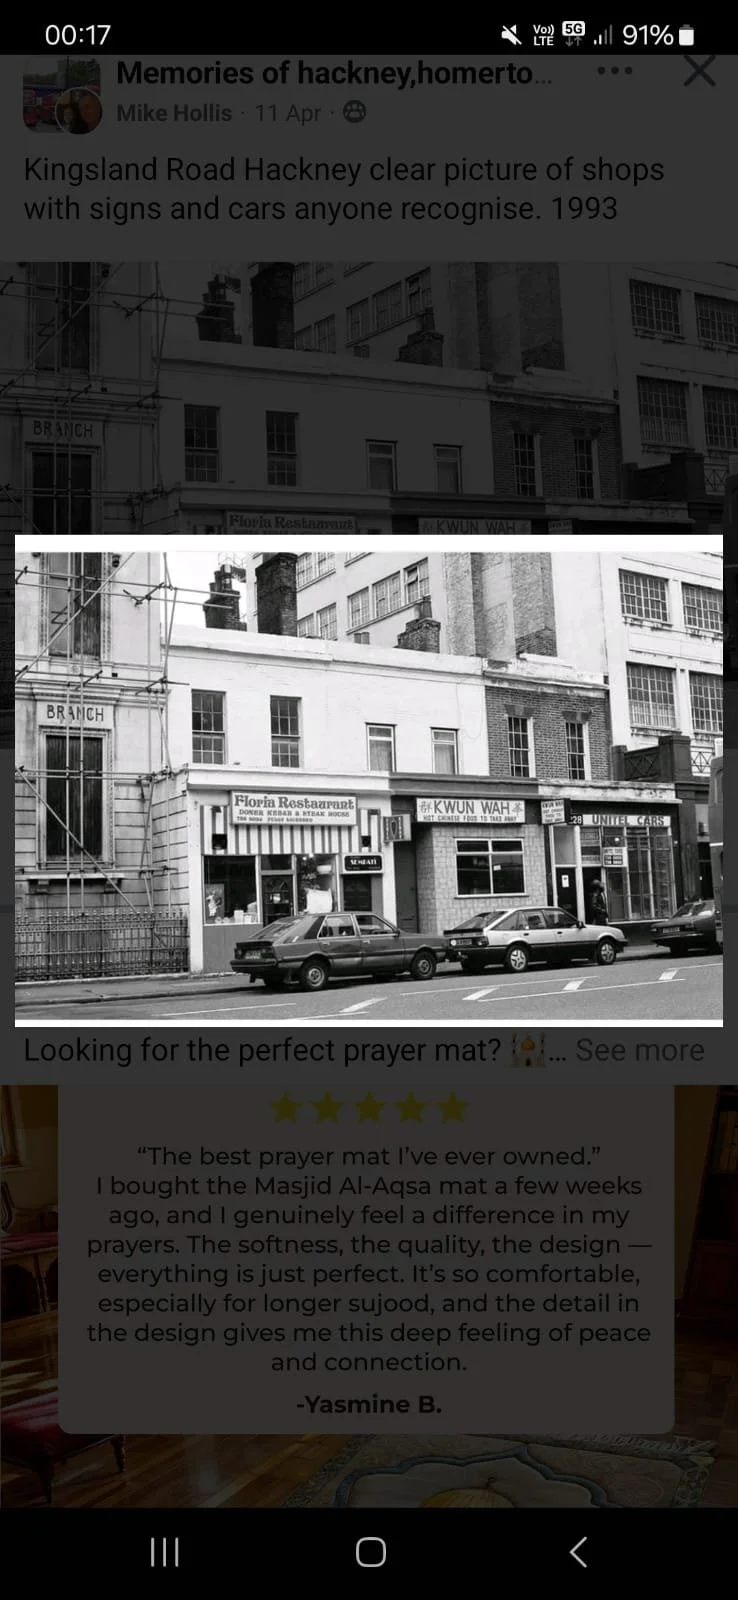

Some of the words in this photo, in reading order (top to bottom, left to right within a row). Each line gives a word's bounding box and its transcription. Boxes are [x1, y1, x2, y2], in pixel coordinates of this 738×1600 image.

[46, 25, 111, 45] 00:17
[565, 23, 583, 35] 5G
[622, 24, 674, 46] 91%
[533, 36, 554, 46] LTE
[118, 61, 253, 84] Memories
[263, 60, 290, 84] of
[117, 104, 168, 122] Mike
[174, 104, 232, 122] Hollis
[256, 105, 276, 121] 11
[286, 104, 321, 126] Apr
[26, 156, 156, 186] Kingsland
[168, 156, 234, 180] Road
[245, 156, 361, 187] Hackney
[370, 156, 436, 180] clear
[445, 156, 536, 186] picture
[547, 156, 574, 180] of
[583, 156, 664, 187] shops
[24, 195, 79, 219] with
[90, 196, 161, 225] signs
[171, 195, 218, 219] and
[229, 202, 285, 219] cars
[296, 202, 392, 226] anyone
[402, 196, 540, 225] recognise.
[552, 196, 617, 219] 1993
[33, 420, 93, 438] BRANCH
[47, 704, 104, 722] BRANCH
[234, 794, 275, 808] Floria
[278, 796, 354, 810] Restaurant
[434, 800, 475, 814] KWUN
[481, 800, 510, 815] WAH
[592, 815, 629, 825] UNITEL
[637, 815, 665, 825] CARS
[25, 1037, 131, 1067] Looking
[141, 1037, 179, 1061] for
[187, 1037, 230, 1061] the
[240, 1037, 335, 1067] perfect
[345, 1044, 426, 1067] prayer
[436, 1037, 502, 1061] mat?
[577, 1038, 625, 1061] See
[636, 1044, 704, 1061] more
[201, 1147, 251, 1165] best
[260, 1152, 334, 1170] prayer
[343, 1148, 390, 1165] mat
[445, 1152, 496, 1165] ever
[97, 1177, 102, 1194] I
[112, 1176, 200, 1199] bought
[206, 1176, 246, 1194] the
[256, 1176, 331, 1199] Masjid
[339, 1176, 430, 1199] Al-Aqsa
[440, 1178, 487, 1194] mat
[495, 1181, 507, 1195] a
[515, 1176, 559, 1194] few
[566, 1176, 642, 1194] weeks
[110, 1210, 159, 1229] ago,
[167, 1205, 211, 1224] and
[220, 1206, 225, 1224] I
[234, 1205, 354, 1229] genuinely
[361, 1205, 403, 1224] feel
[413, 1210, 424, 1224] a
[433, 1205, 554, 1224] difference
[564, 1205, 583, 1224] in
[593, 1210, 629, 1229] my
[88, 1240, 179, 1258] prayers.
[186, 1235, 231, 1253] The
[238, 1235, 343, 1256] softness,
[350, 1234, 390, 1253] the
[398, 1235, 484, 1258] quality,
[492, 1235, 532, 1253] the
[540, 1235, 619, 1258] design
[98, 1264, 228, 1287] everything
[237, 1264, 254, 1283] is
[258, 1264, 305, 1287] just
[314, 1264, 404, 1287] perfect.
[452, 1269, 479, 1283] so
[486, 1264, 639, 1286] comfortable,
[99, 1293, 216, 1317] especially
[224, 1293, 256, 1312] for
[265, 1293, 341, 1317] longer
[349, 1293, 434, 1316] sujood,
[443, 1293, 487, 1312] and
[496, 1293, 535, 1312] the
[543, 1293, 609, 1312] detail
[619, 1293, 638, 1312] in
[87, 1323, 127, 1342] the
[135, 1323, 215, 1346] design
[224, 1322, 285, 1346] gives
[294, 1328, 331, 1341] me
[339, 1322, 383, 1341] this
[391, 1322, 451, 1346] deep
[458, 1322, 540, 1346] feeling
[549, 1323, 572, 1341] of
[580, 1328, 650, 1346] peace
[272, 1352, 316, 1371] and
[325, 1352, 466, 1371] connection.
[297, 1393, 410, 1413] -Yasmine
[419, 1396, 442, 1413] B.
